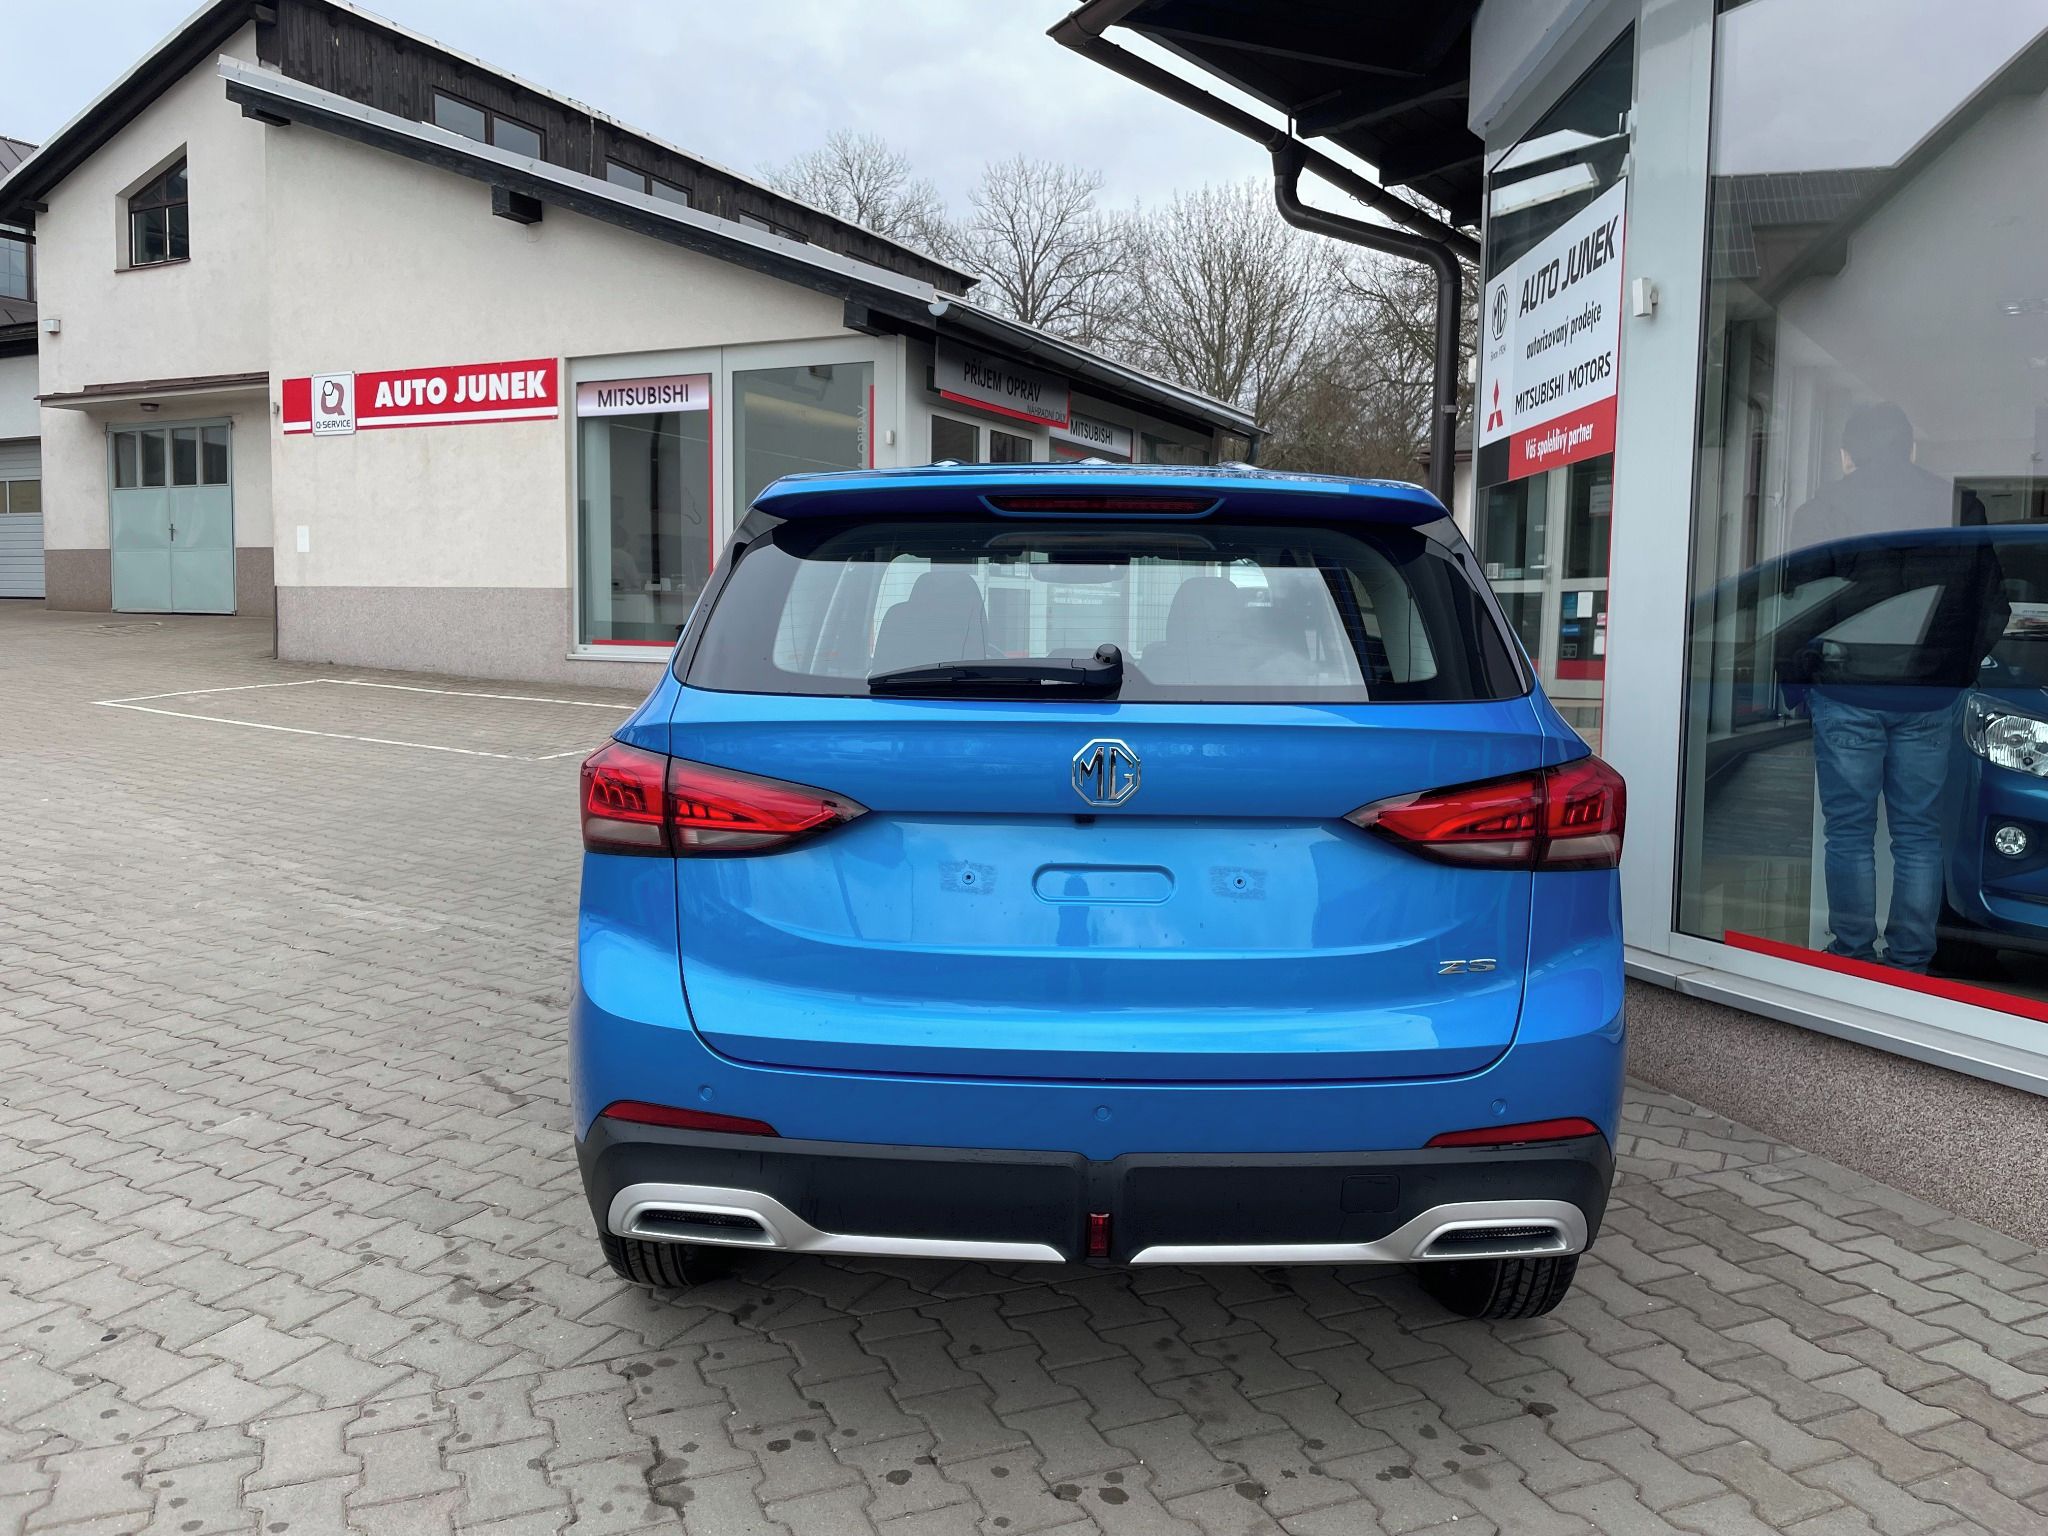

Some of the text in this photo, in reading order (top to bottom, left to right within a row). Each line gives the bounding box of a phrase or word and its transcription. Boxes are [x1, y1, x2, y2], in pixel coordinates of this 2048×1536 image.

[1519, 214, 1619, 319] AUTO JUNEK
[1493, 286, 1508, 339] MG
[1526, 315, 1569, 360] autorizovaný
[1570, 301, 1601, 344] prodejce
[374, 369, 547, 408] AUTO JUNEK
[597, 384, 689, 408] MITSUBISHI
[964, 358, 1042, 402] PŘÍJEM OPRAV
[1515, 351, 1611, 415] MITSUBISHI MOTORS
[1070, 419, 1113, 446] MITSUBISHI
[1568, 423, 1594, 453] partner
[1077, 743, 1137, 802] MG
[1438, 958, 1497, 975] ZS
